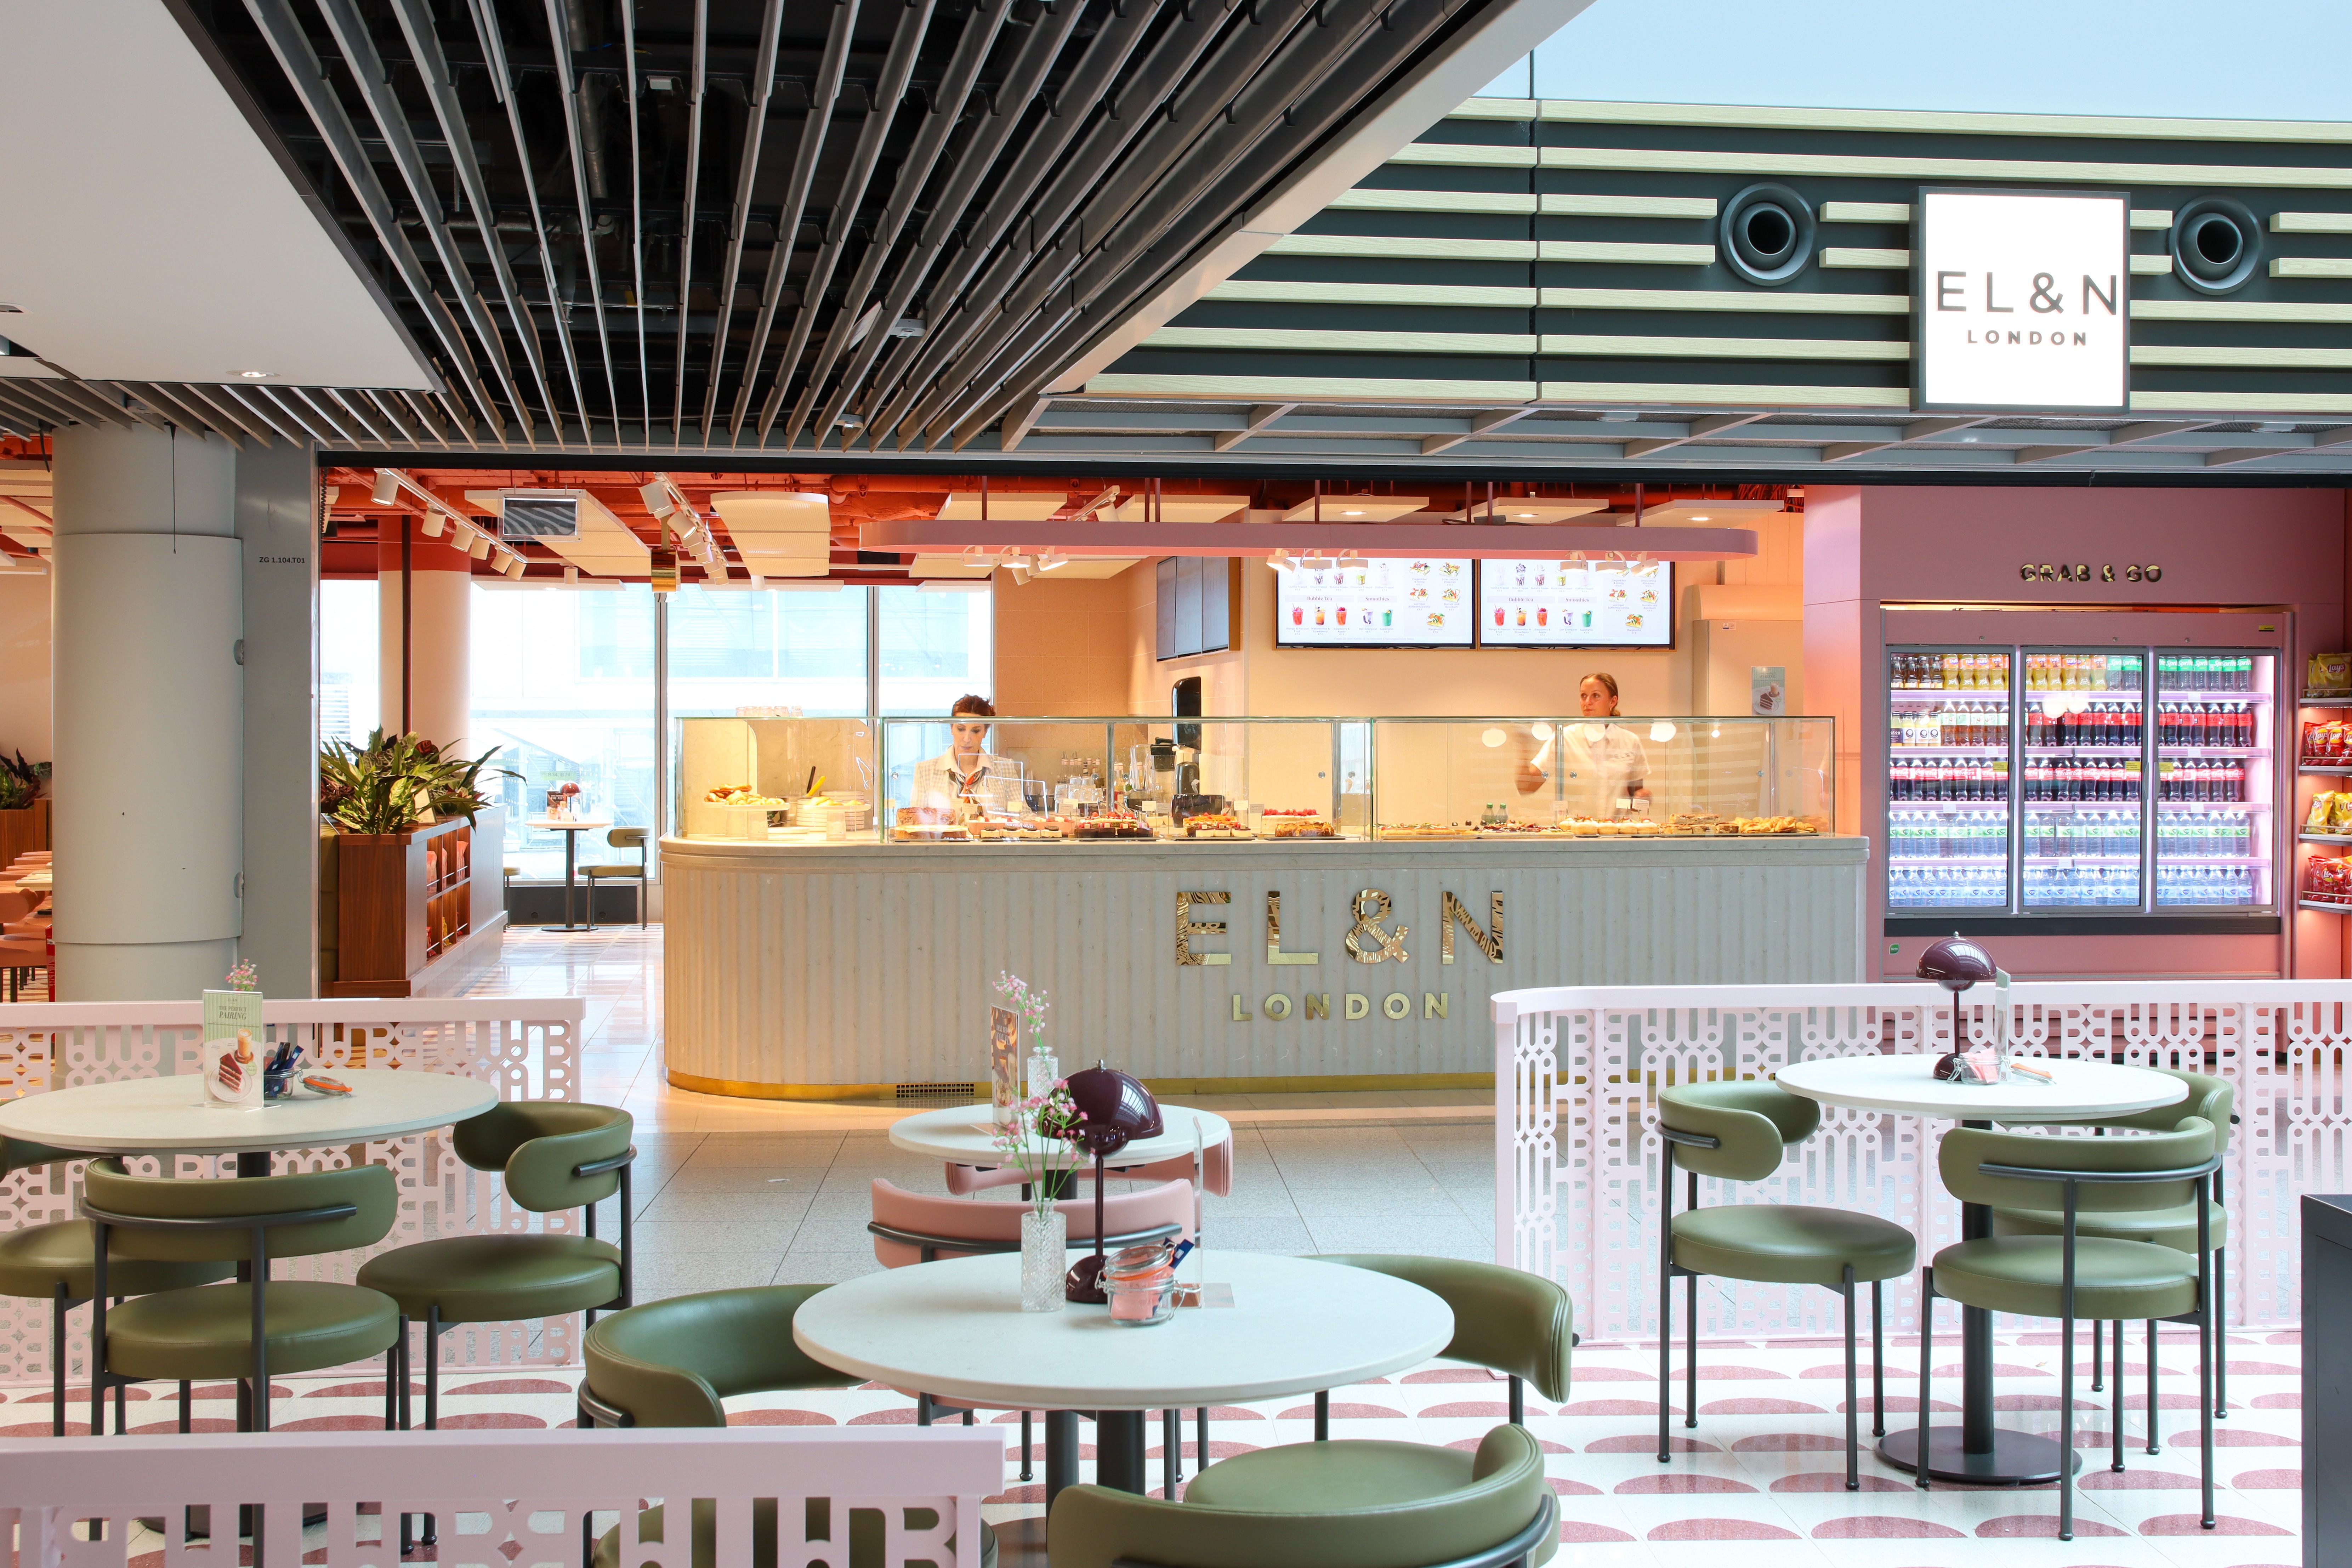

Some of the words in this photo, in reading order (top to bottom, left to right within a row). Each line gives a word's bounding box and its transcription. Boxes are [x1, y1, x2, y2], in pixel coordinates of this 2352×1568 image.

[1936, 271, 2117, 315] EL&N
[1966, 330, 2086, 346] LONDON
[2021, 564, 2091, 582] GRAB
[2101, 564, 2115, 582] &
[2126, 564, 2162, 582] GO
[1177, 888, 1503, 965] EL&N
[219, 1011, 247, 1020] PAIRING
[1233, 993, 1448, 1020] LONDON
[996, 1032, 1005, 1041] YOU
